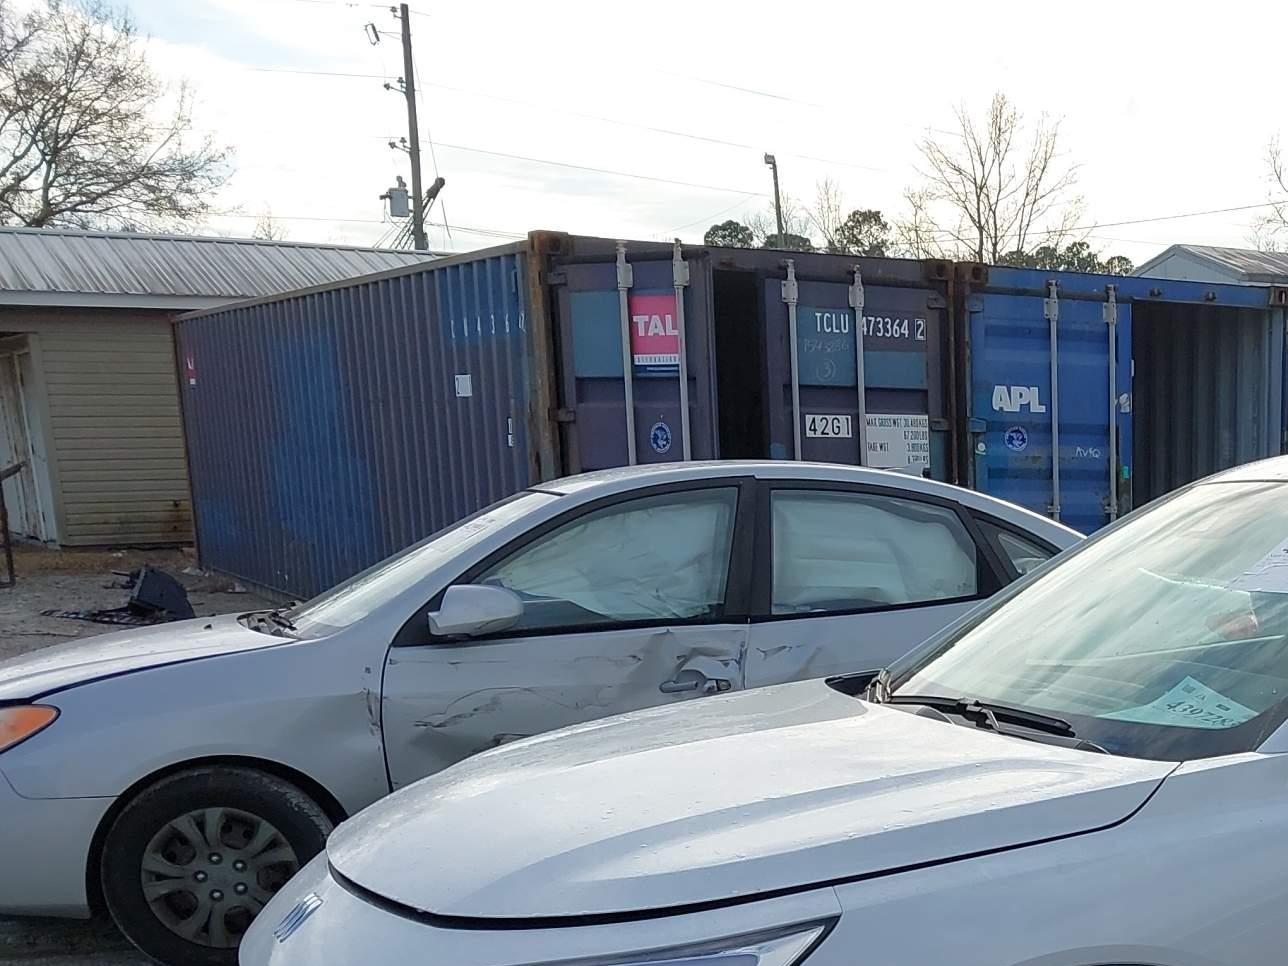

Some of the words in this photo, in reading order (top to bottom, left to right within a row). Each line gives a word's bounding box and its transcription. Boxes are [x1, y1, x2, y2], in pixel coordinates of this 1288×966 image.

[633, 314, 679, 337] TAL
[815, 313, 849, 333] TCLU
[917, 320, 924, 338] 2
[992, 385, 1046, 413] APL
[808, 417, 850, 436] 42G1
